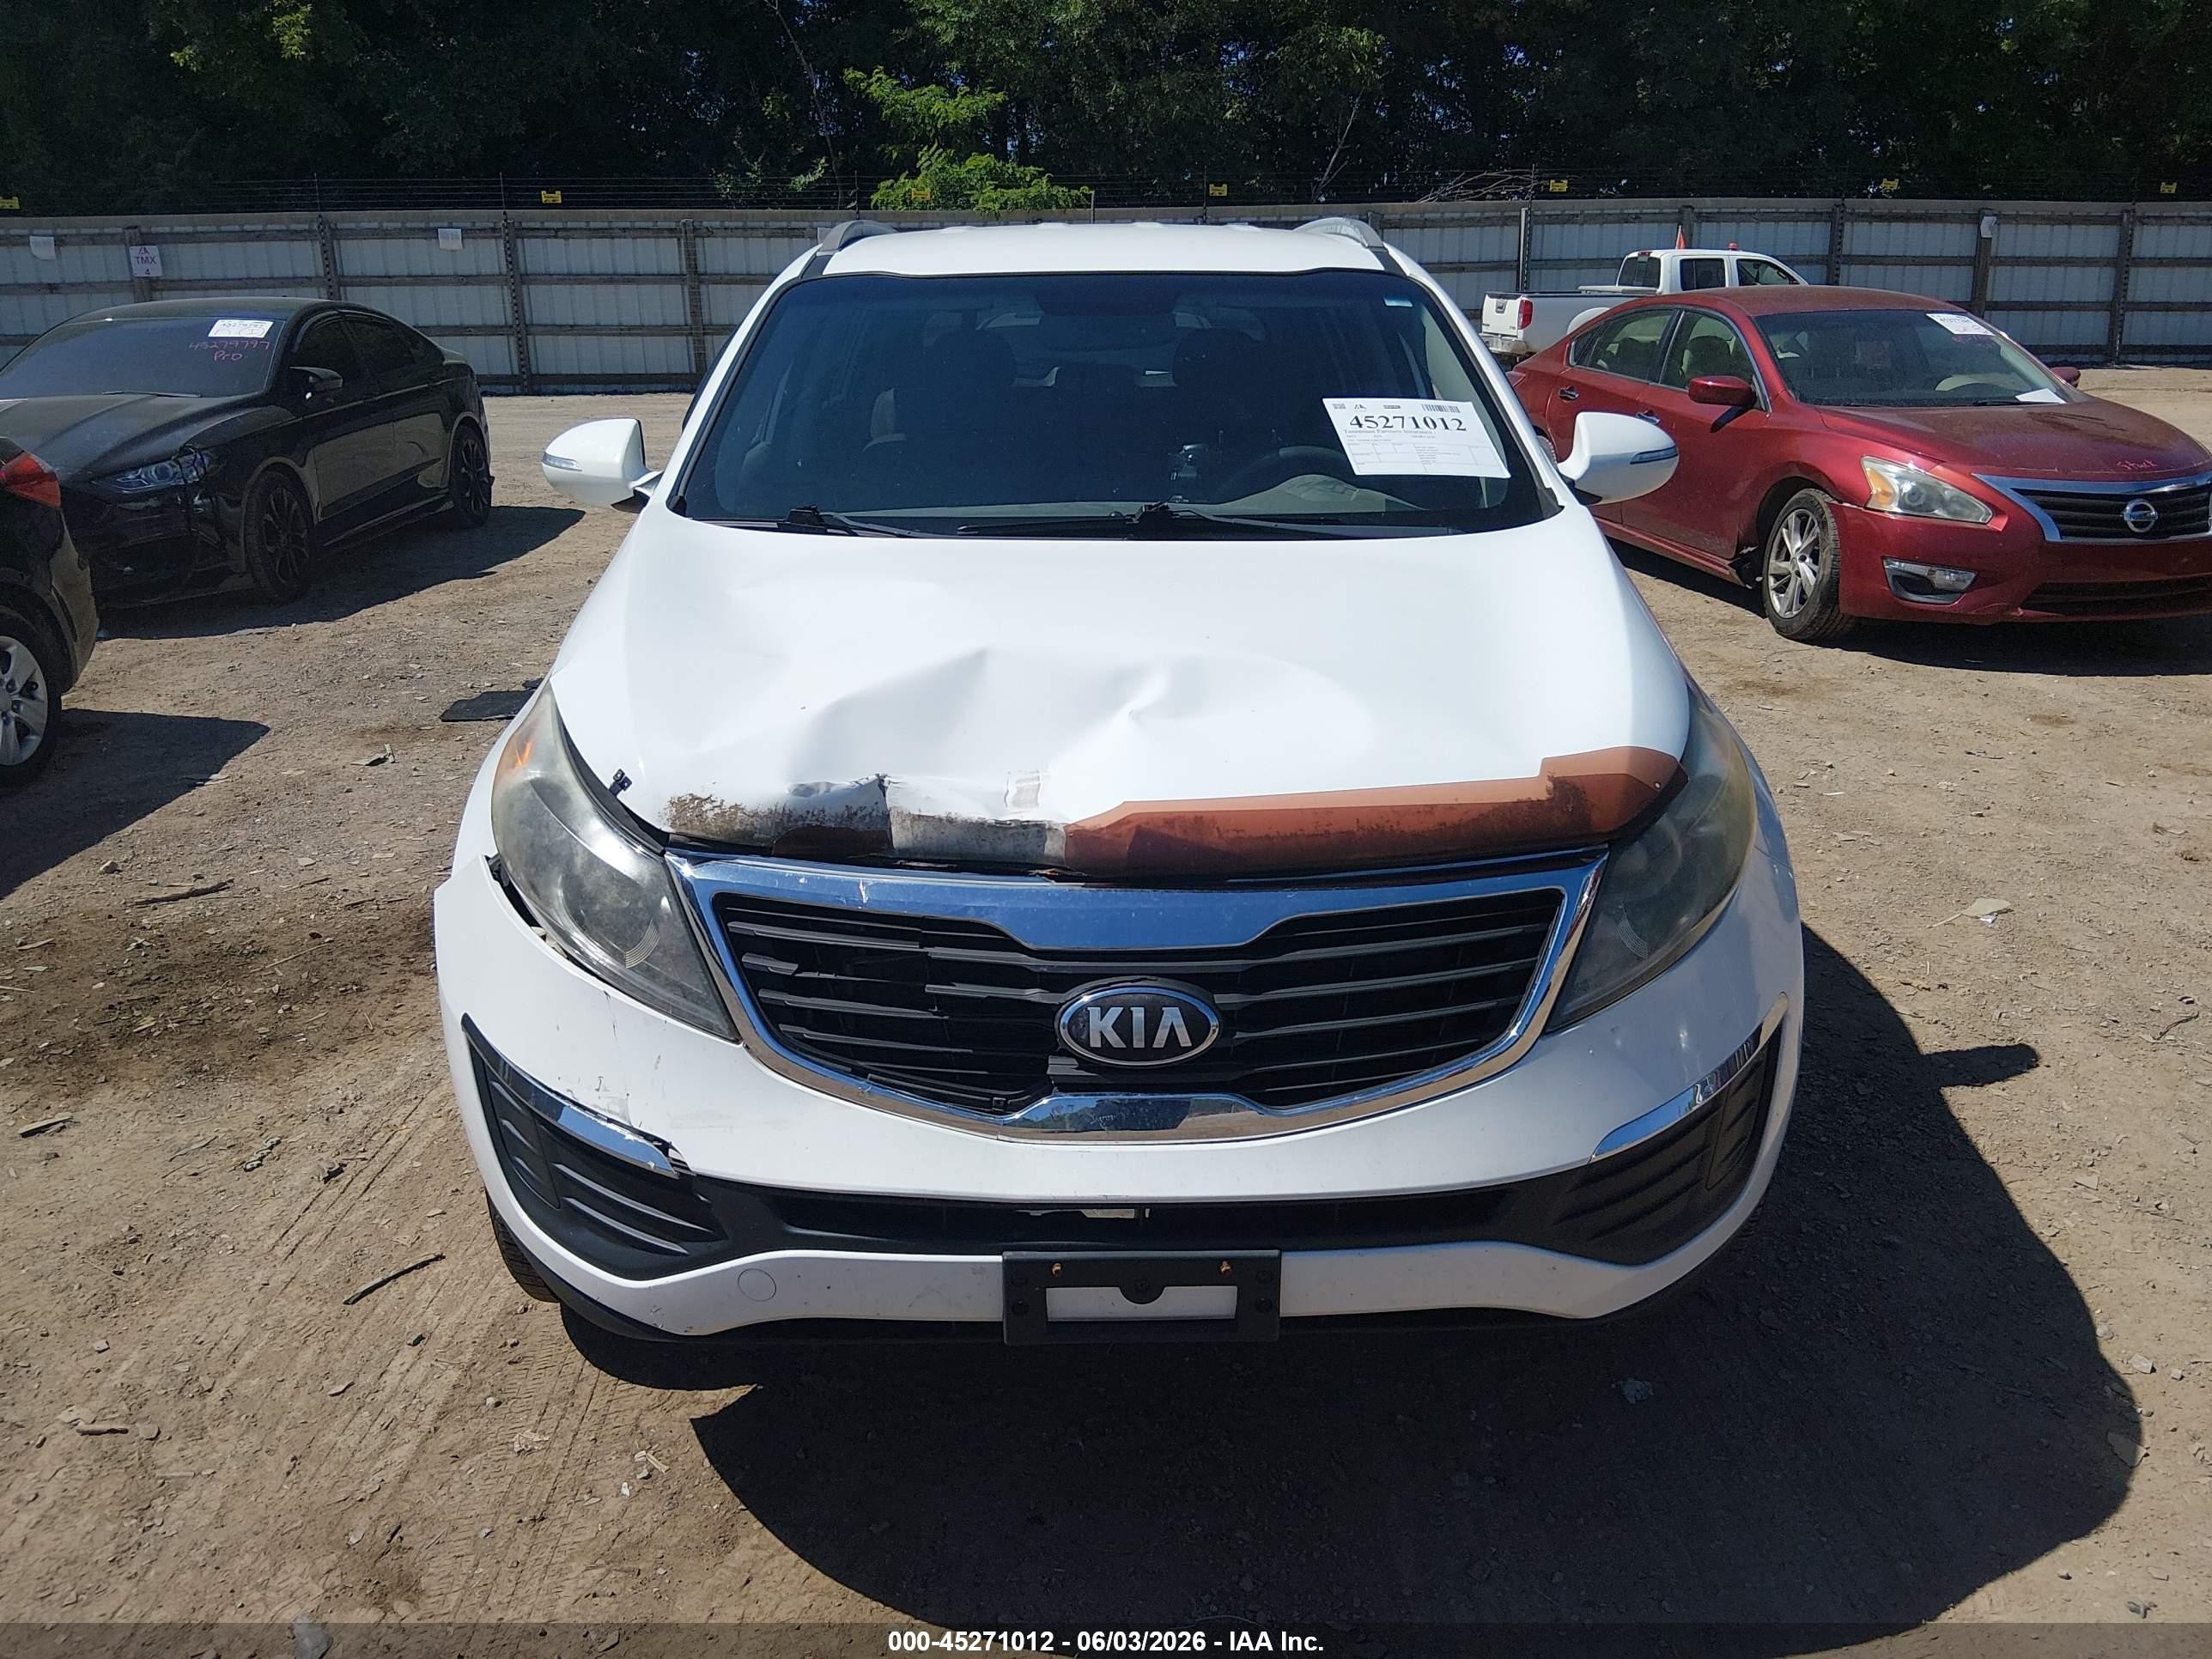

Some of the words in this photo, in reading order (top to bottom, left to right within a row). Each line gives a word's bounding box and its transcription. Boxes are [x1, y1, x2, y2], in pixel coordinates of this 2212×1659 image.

[135, 255, 157, 264] TMX
[1349, 415, 1467, 432] 45271012
[1086, 1006, 1193, 1048] KIA
